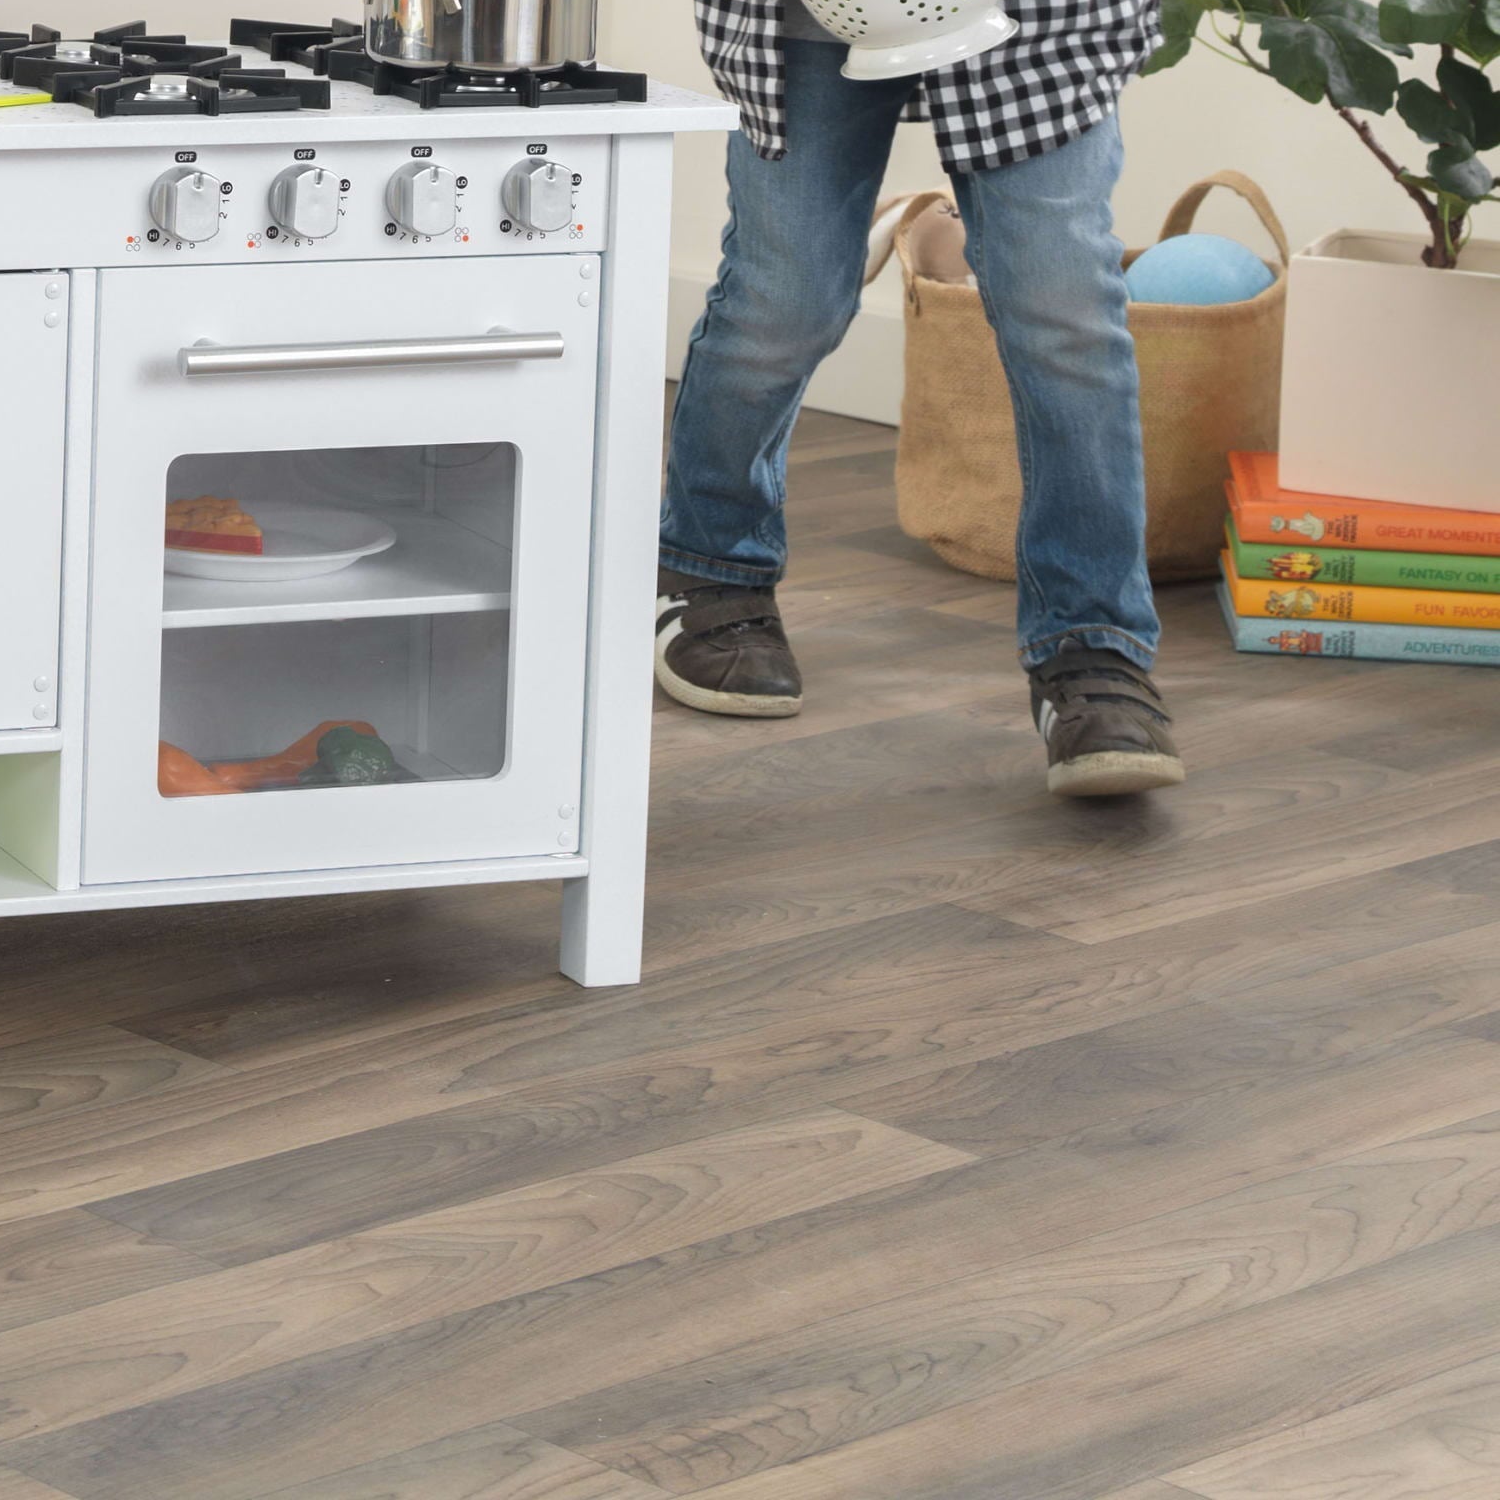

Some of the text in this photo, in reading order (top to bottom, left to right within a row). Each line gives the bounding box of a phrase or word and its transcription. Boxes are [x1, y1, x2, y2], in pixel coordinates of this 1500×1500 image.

[413, 148, 430, 156] OFF
[529, 145, 546, 154] OFF
[177, 153, 195, 161] OFF
[296, 151, 313, 159] OFF
[399, 232, 407, 240] 7
[514, 228, 522, 237] 7
[526, 232, 533, 241] 6
[162, 238, 170, 247] 7
[281, 235, 289, 243] 7
[294, 238, 300, 247] 6
[412, 235, 419, 244] 6
[175, 241, 182, 251] 6
[1375, 524, 1423, 539] GREAT
[1399, 566, 1462, 581] FANTASY
[1466, 571, 1489, 583] ON
[1414, 603, 1445, 617] FUN
